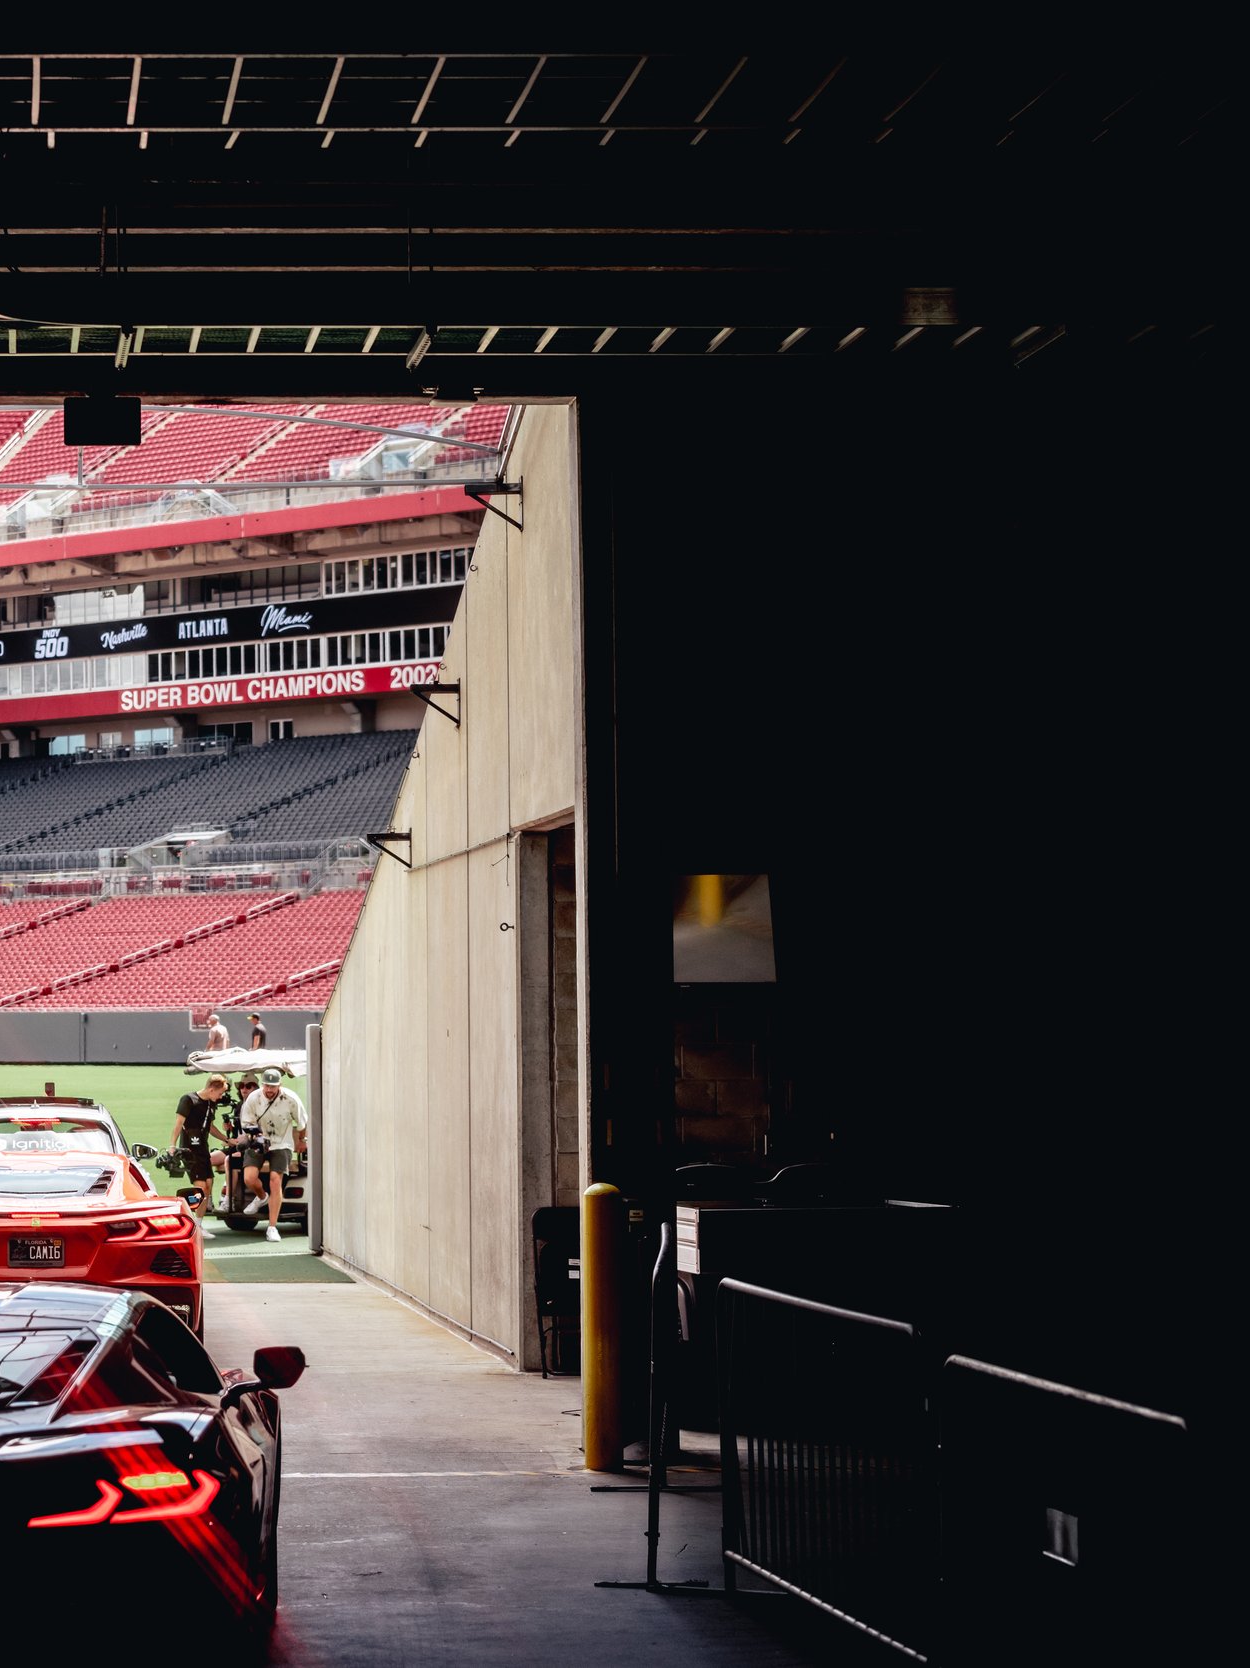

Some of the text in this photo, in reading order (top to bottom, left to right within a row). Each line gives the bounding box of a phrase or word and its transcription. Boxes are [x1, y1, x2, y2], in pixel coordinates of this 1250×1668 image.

[178, 617, 229, 640] ATLANTA
[260, 604, 313, 637] Miami
[42, 628, 61, 639] INDY
[100, 623, 148, 650] Nashville
[34, 636, 69, 659] 500
[121, 664, 438, 711] SUPER BOWL CHAMPIONS 2002
[12, 1137, 75, 1150] Ignitio
